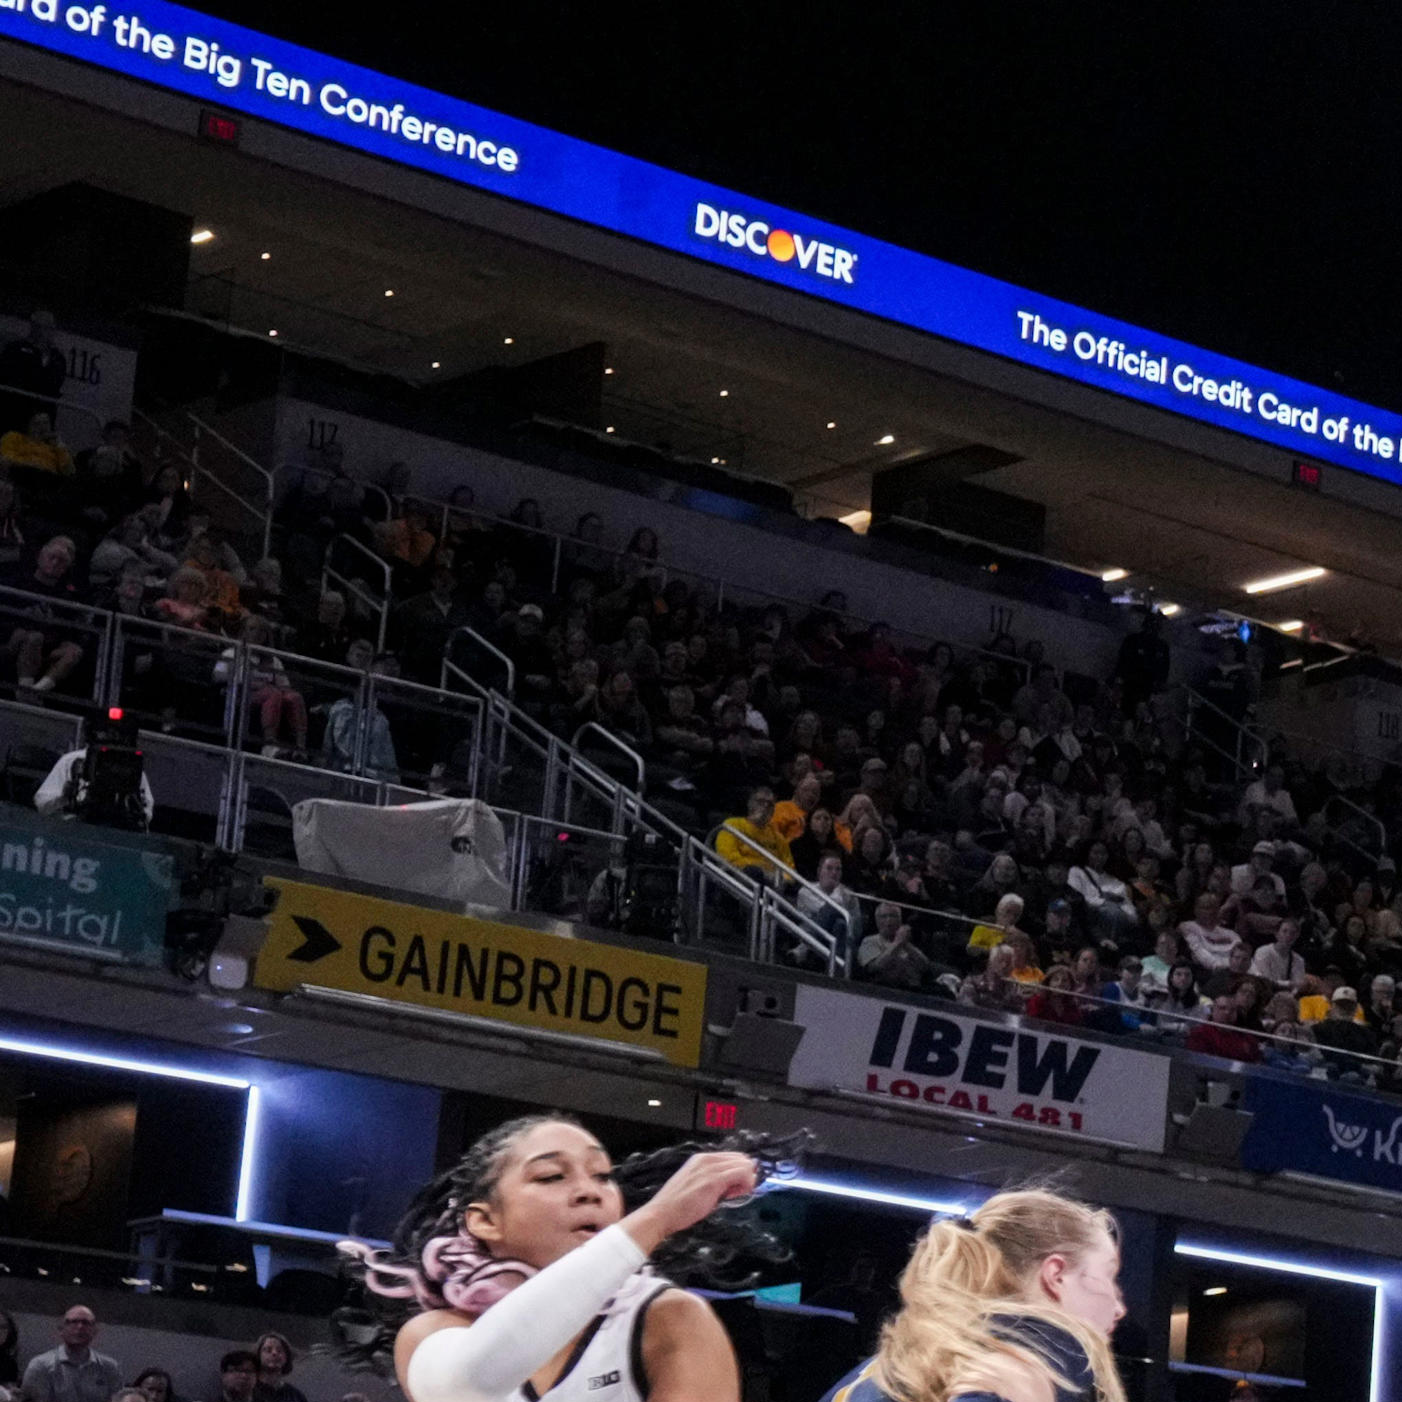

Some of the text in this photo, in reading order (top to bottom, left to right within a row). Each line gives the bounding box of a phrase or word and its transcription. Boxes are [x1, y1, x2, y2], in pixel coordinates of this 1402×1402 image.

[65, 5, 107, 36] of
[112, 15, 175, 60] the
[183, 36, 242, 88] Big
[251, 57, 311, 105] Ten
[319, 83, 519, 172] Conference
[694, 202, 858, 284] DISCOVER
[1017, 310, 1068, 351] The
[1073, 331, 1168, 385] Official
[1172, 364, 1253, 414] Credit
[1257, 393, 1319, 434] Card
[1322, 417, 1349, 443] of
[1353, 425, 1394, 458] the
[358, 925, 683, 1039] GAINBRIDGE
[866, 1073, 1084, 1131] LOCAL 481
[868, 1006, 1103, 1104] IBEW
